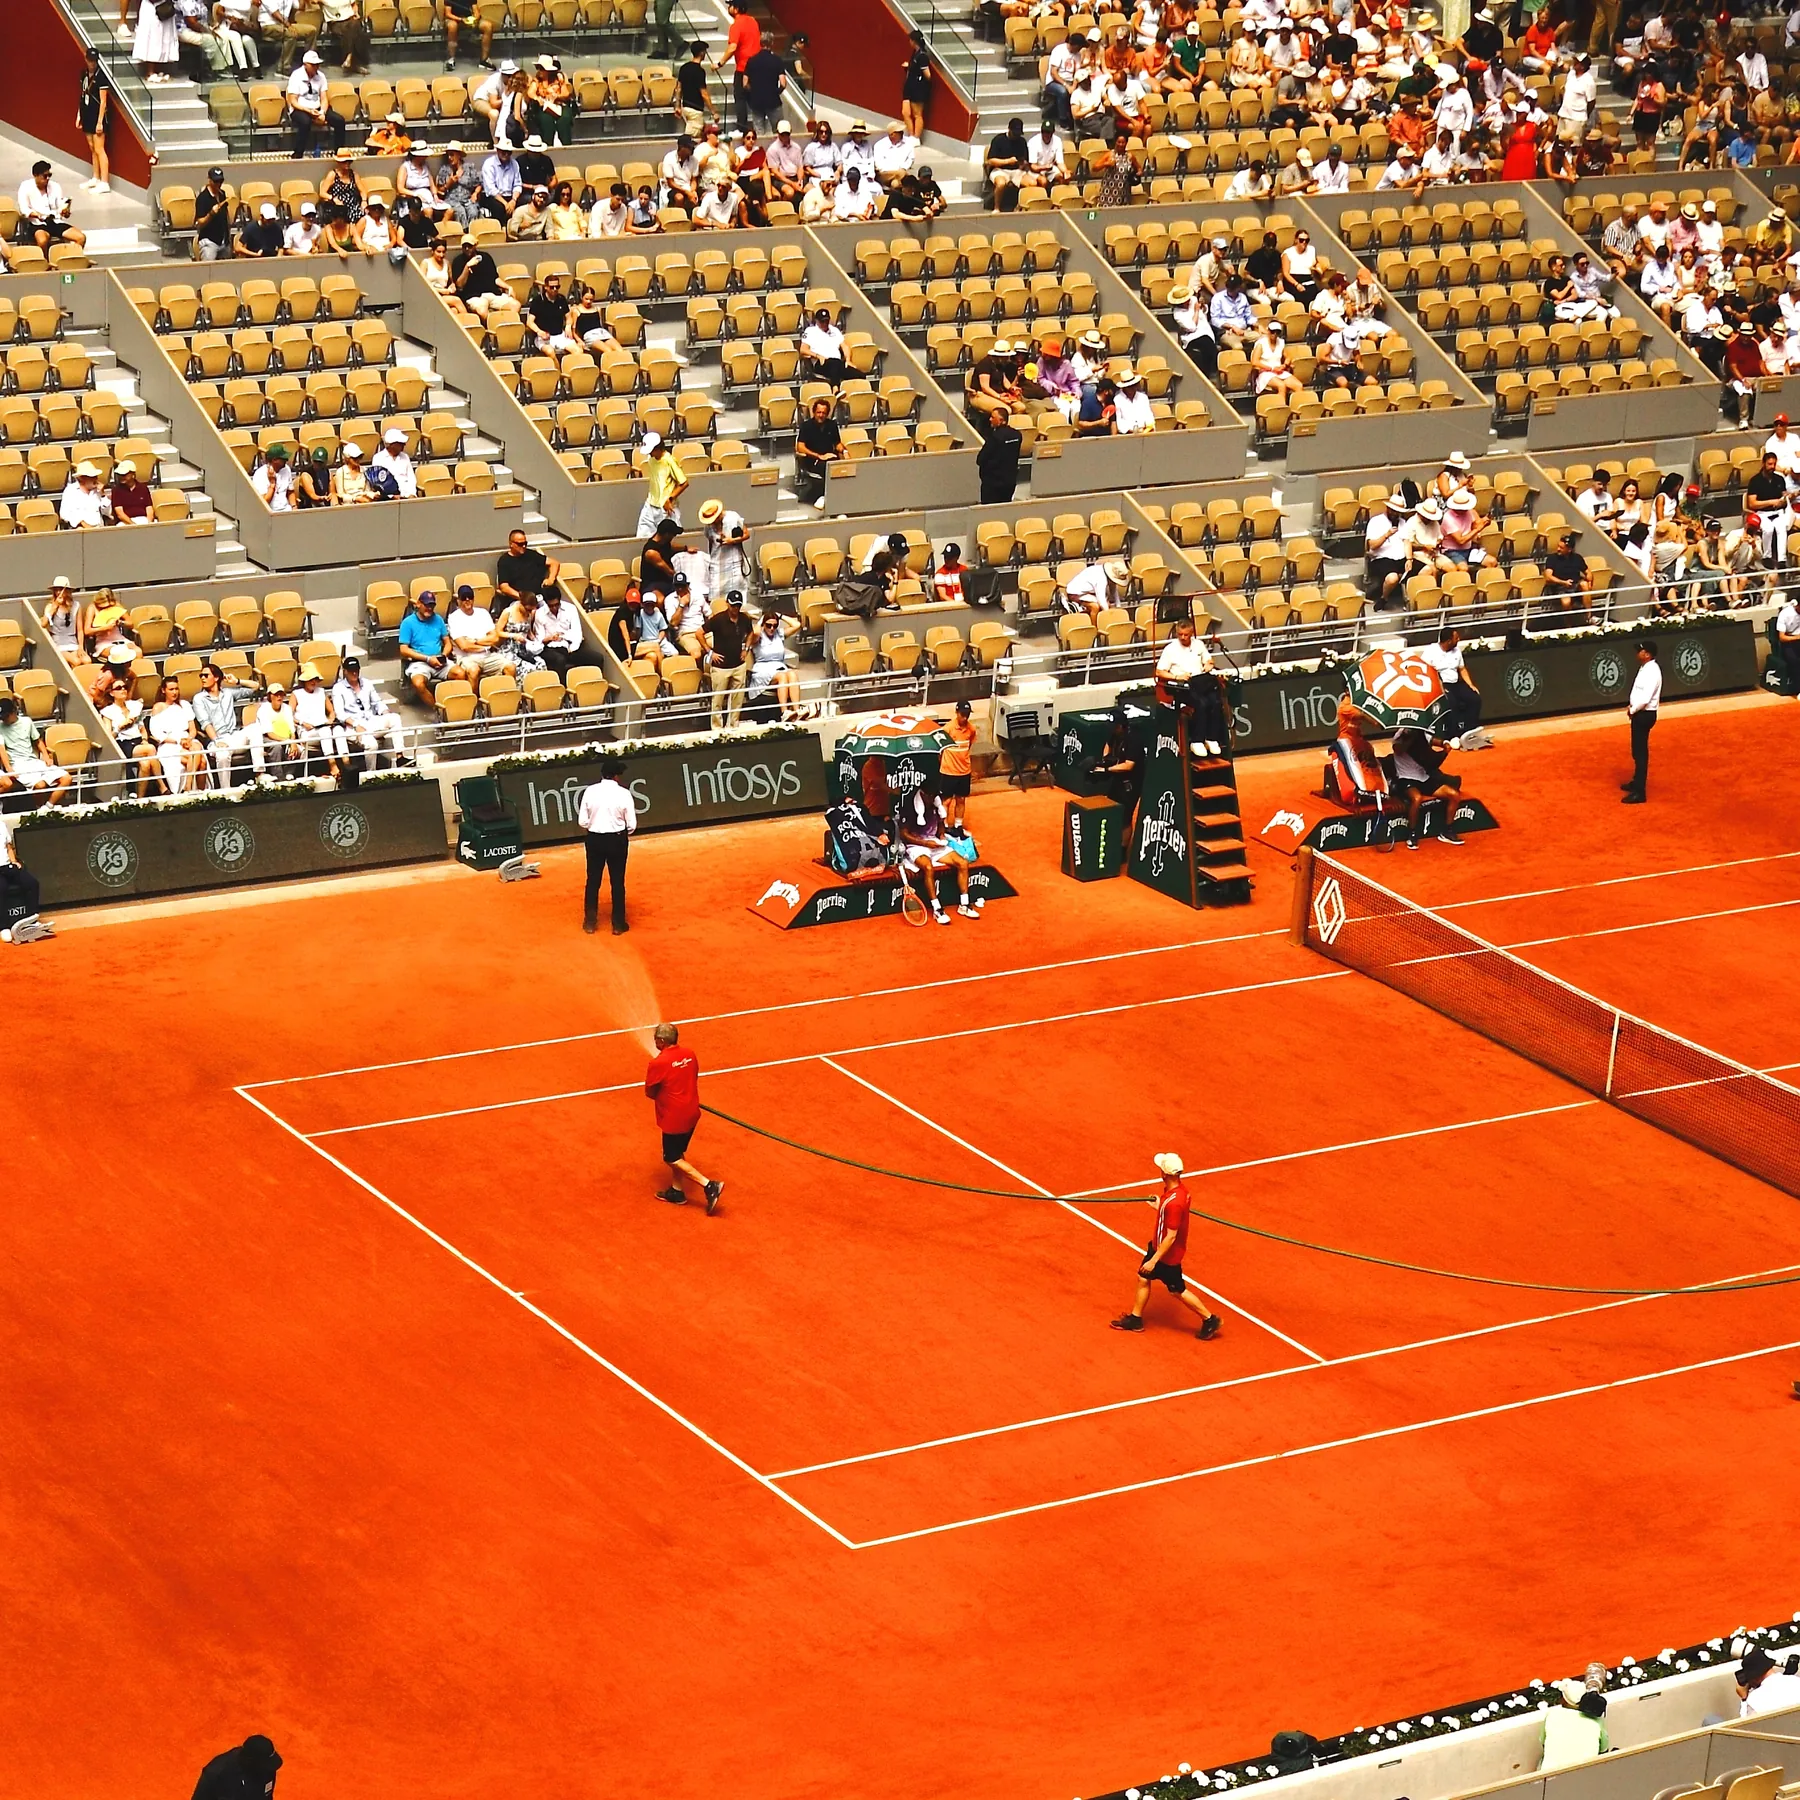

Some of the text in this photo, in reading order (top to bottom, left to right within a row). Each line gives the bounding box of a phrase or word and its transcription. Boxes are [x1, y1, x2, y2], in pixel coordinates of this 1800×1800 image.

[1280, 686, 1346, 731] Info
[682, 758, 801, 806] Infosys
[206, 820, 252, 853] ROLAND GARROS
[322, 806, 367, 839] ROLAND GARROS
[1320, 822, 1348, 848] Perrier
[89, 834, 136, 868] ROLAND GARROS
[483, 845, 517, 858] LACOSTE
[1071, 813, 1082, 866] Wilson
[816, 892, 847, 921] Perrier
